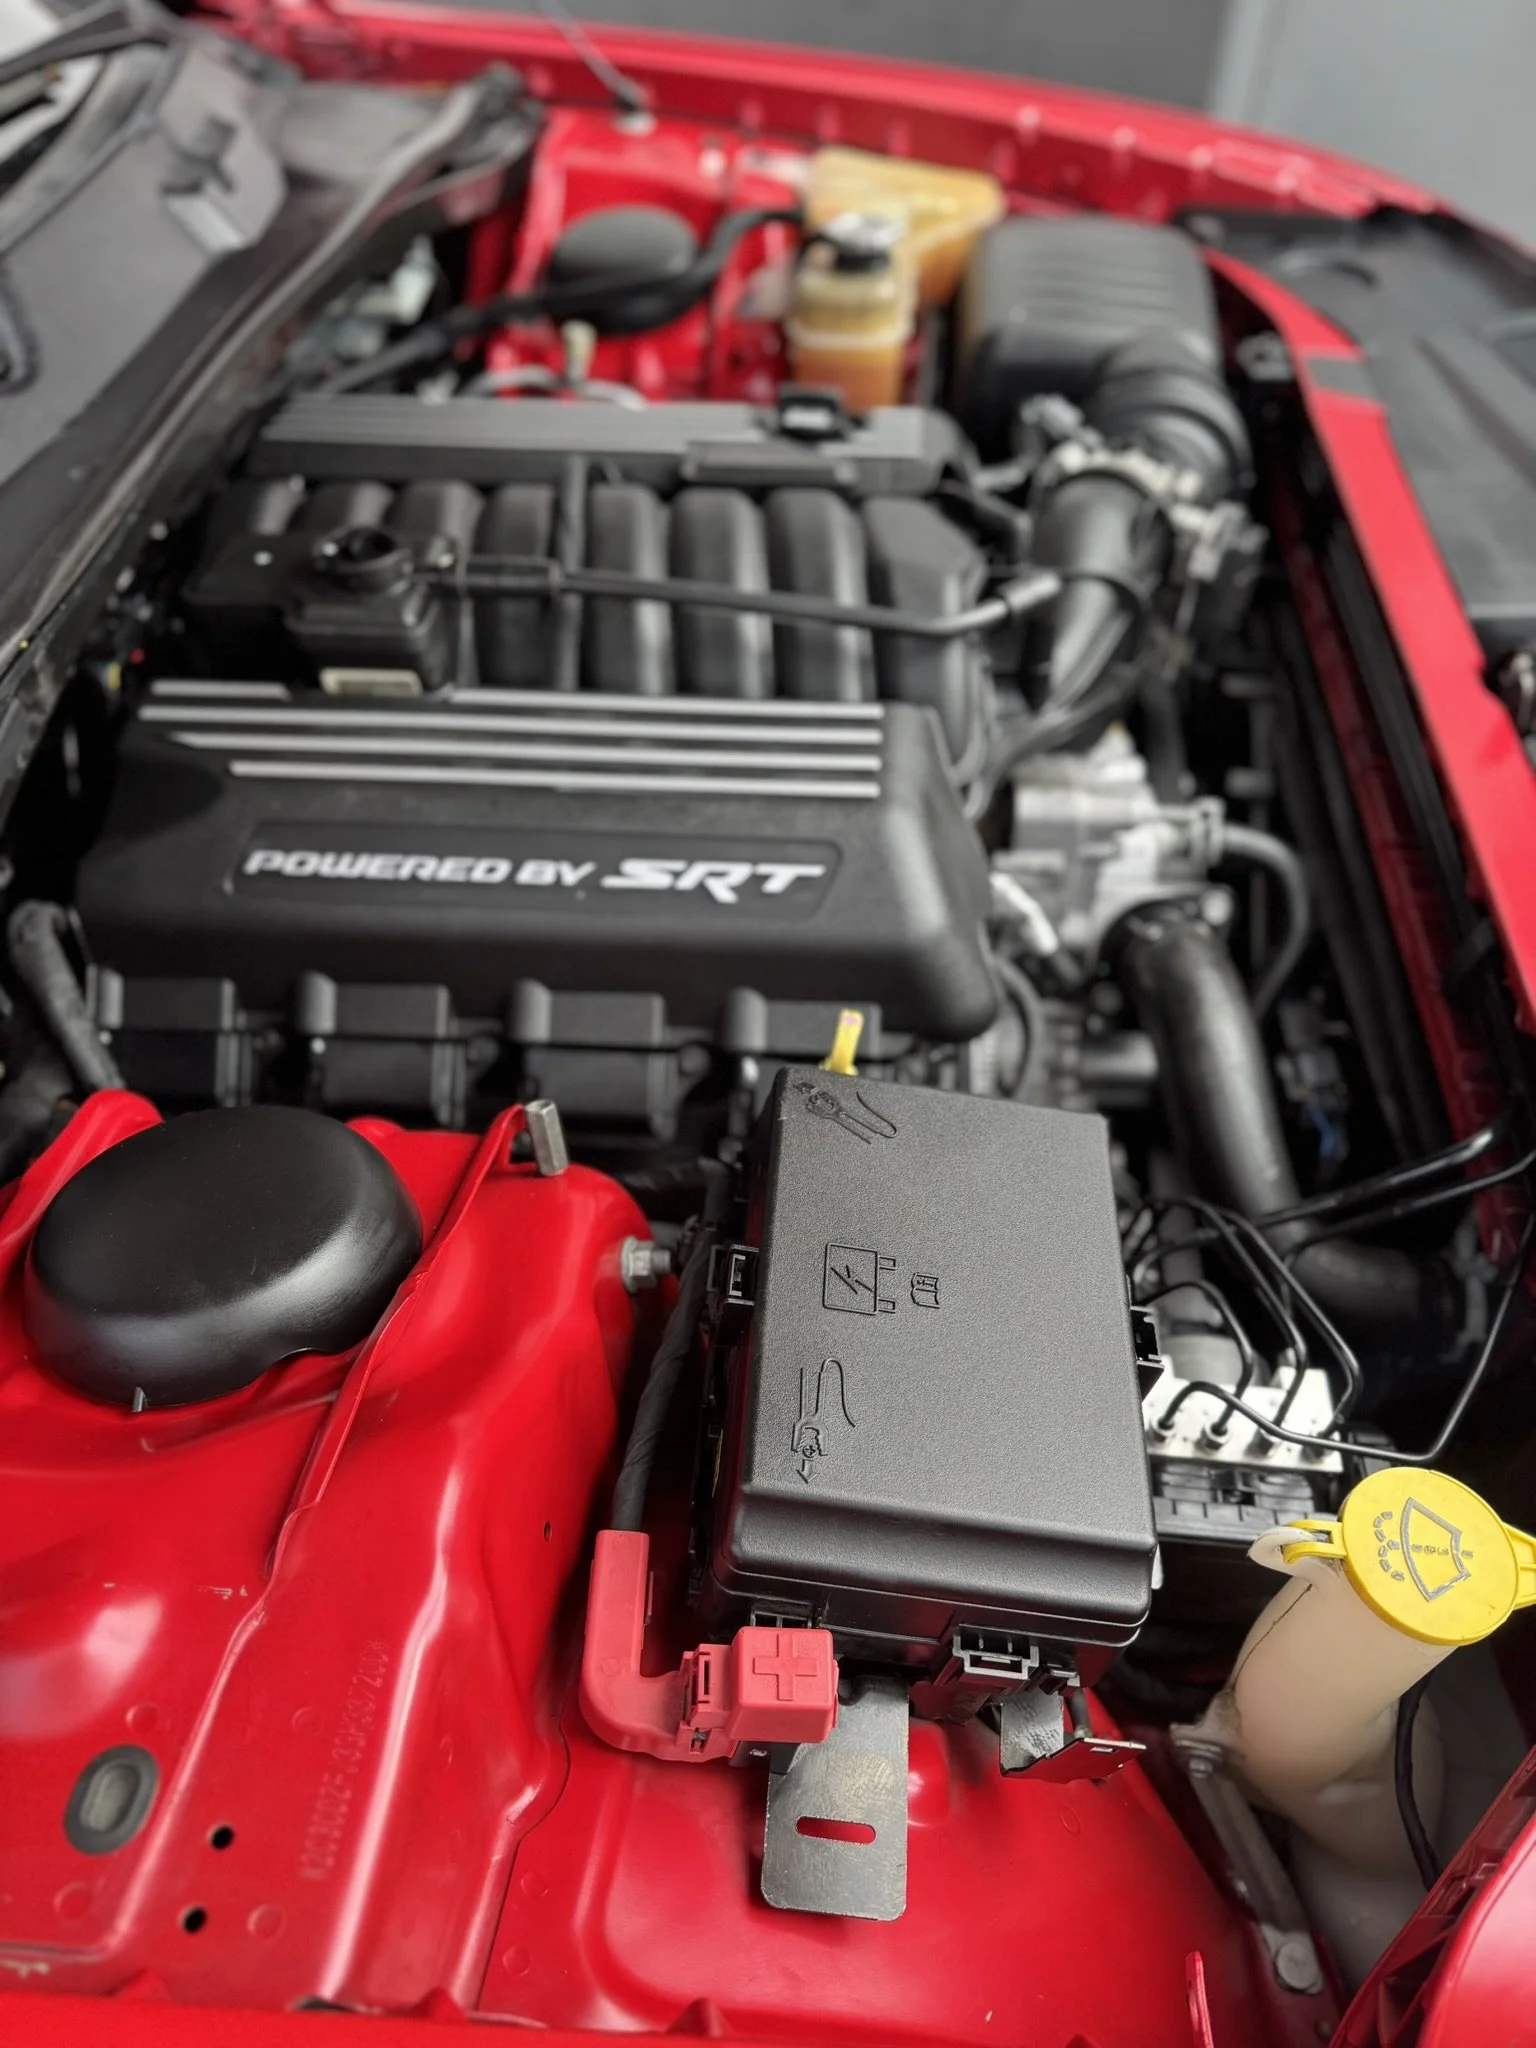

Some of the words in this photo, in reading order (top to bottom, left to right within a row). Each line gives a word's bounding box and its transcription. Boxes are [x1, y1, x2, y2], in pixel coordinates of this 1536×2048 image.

[244, 848, 512, 885] POWERED
[515, 859, 597, 887] BY
[601, 857, 826, 904] SRT
